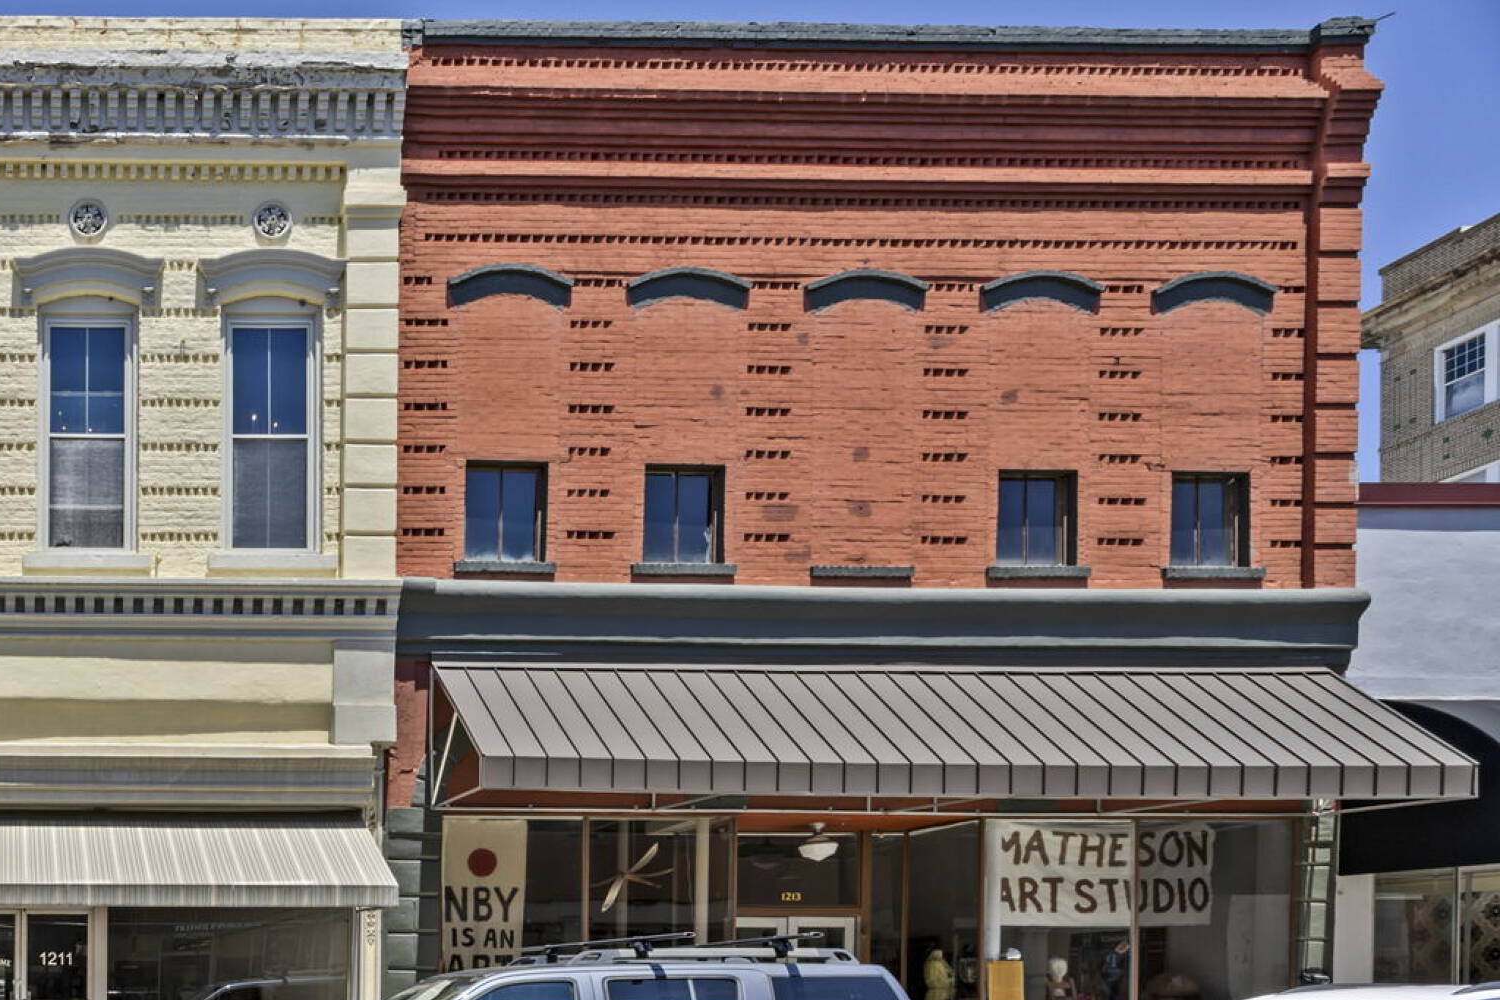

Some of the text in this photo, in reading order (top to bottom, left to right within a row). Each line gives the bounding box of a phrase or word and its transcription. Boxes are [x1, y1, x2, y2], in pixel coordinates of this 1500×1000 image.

[1001, 829, 1208, 867] MATHESON
[444, 885, 519, 923] NBY
[780, 891, 802, 902] 1213
[1001, 876, 1210, 914] ART STUDIO
[451, 927, 515, 949] IS AN
[39, 951, 73, 967] 1211
